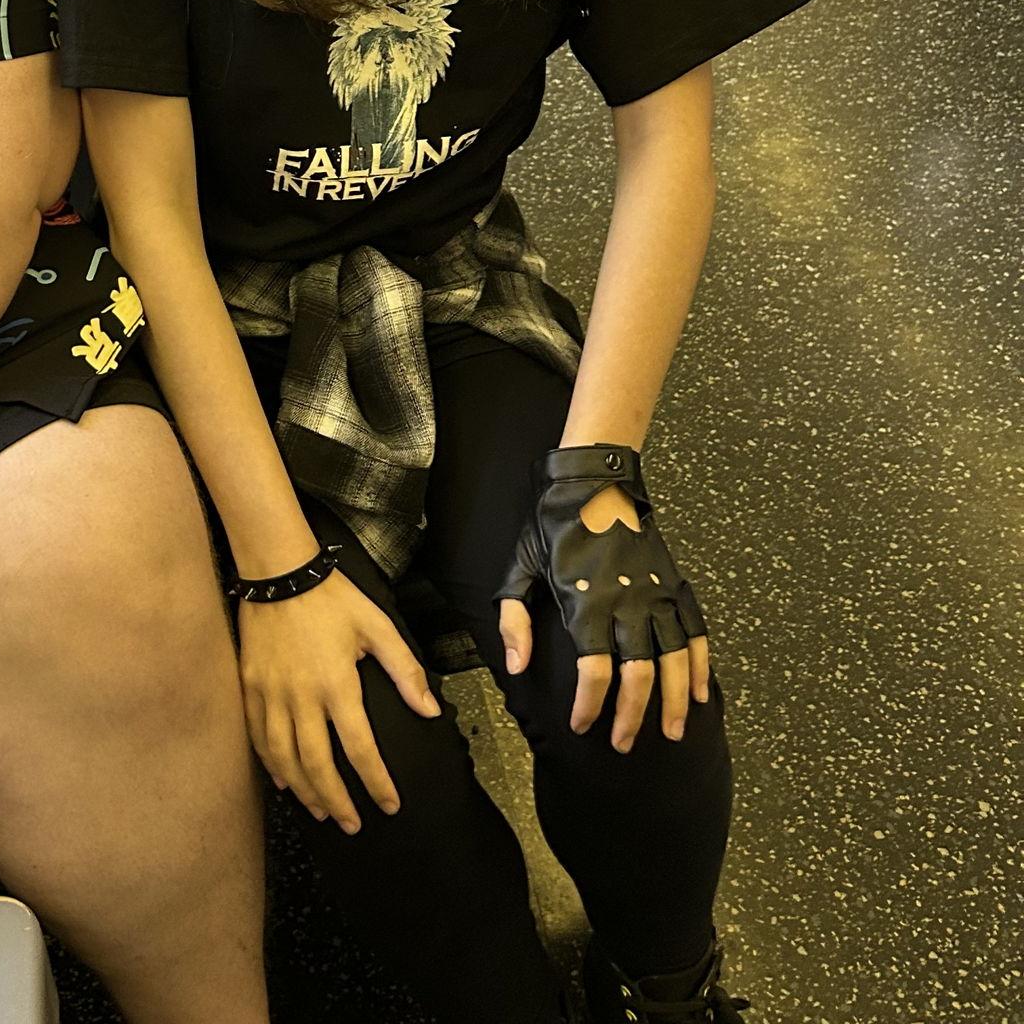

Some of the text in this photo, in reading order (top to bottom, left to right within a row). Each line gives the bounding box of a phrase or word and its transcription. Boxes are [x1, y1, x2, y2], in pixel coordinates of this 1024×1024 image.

[275, 128, 481, 182] FALLING
[272, 172, 308, 199] IN
[71, 276, 146, 375] 東京
